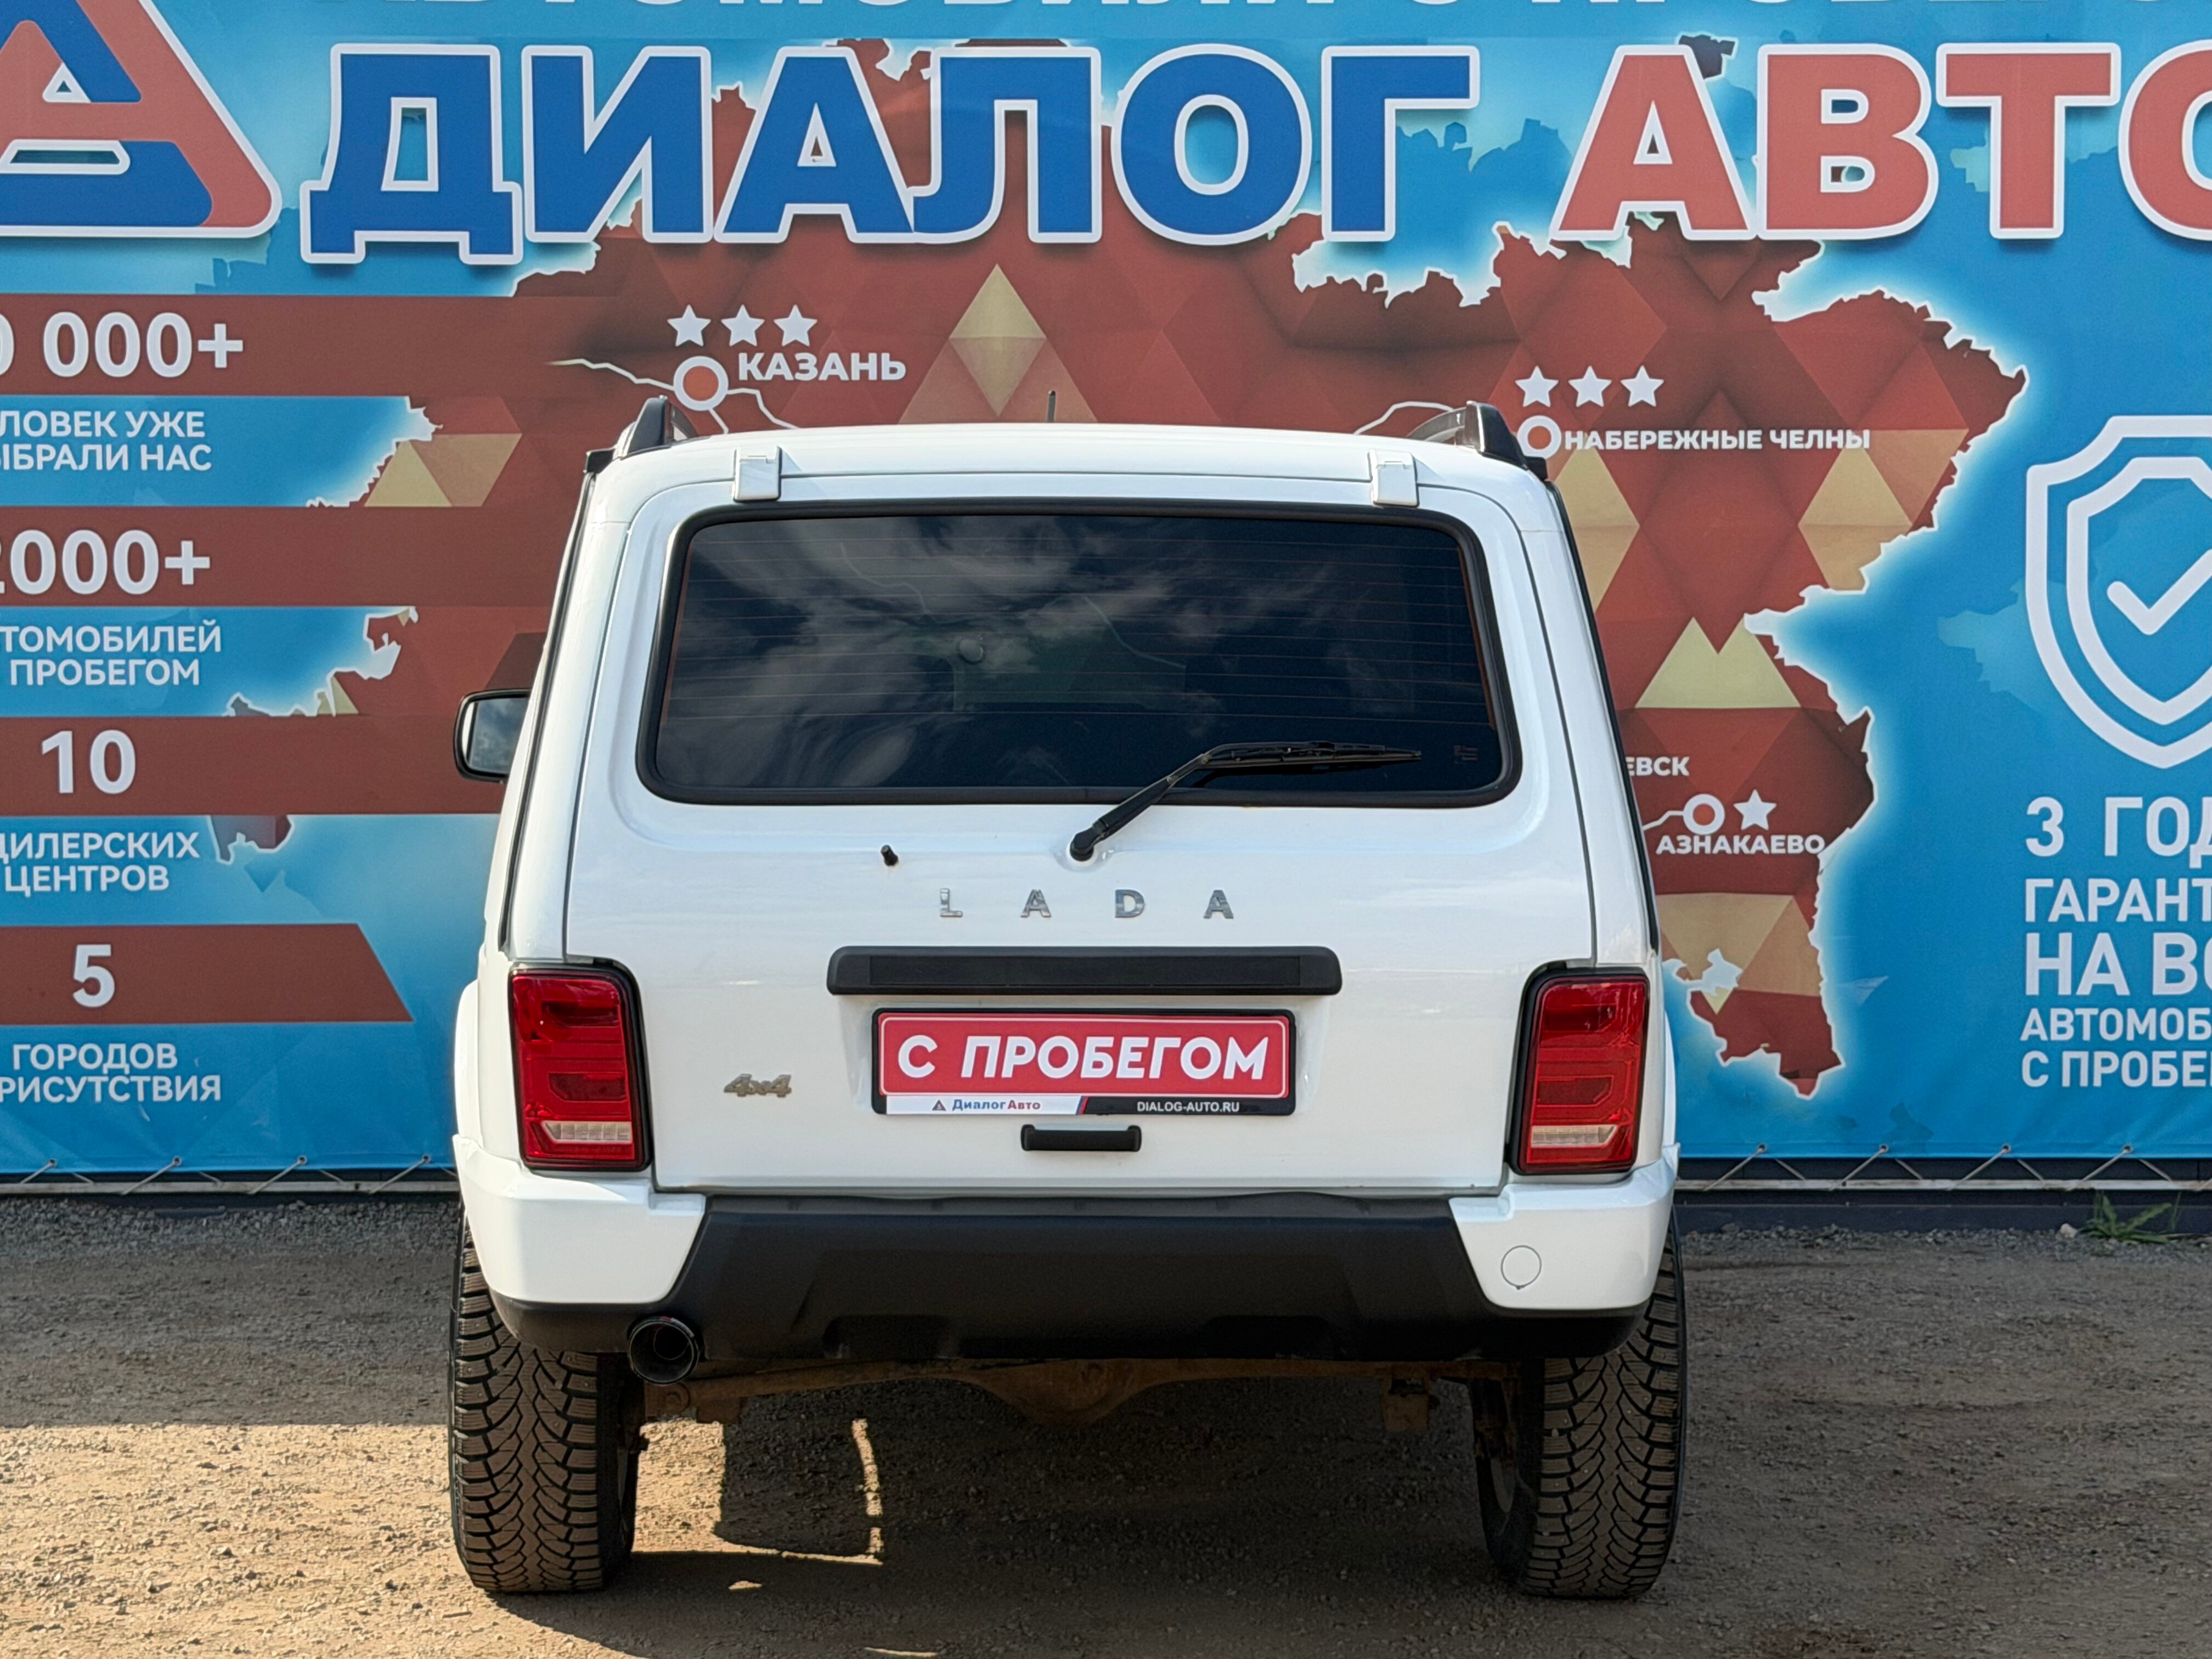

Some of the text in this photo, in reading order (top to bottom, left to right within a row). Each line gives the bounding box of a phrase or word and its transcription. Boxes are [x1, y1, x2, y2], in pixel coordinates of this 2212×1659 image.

[300, 44, 1480, 264] ДИАЛОГ
[738, 352, 906, 381] КАЗАНЬ
[125, 410, 205, 438] УЖЕ
[1565, 429, 1871, 450] НАБЕРЕЖНЫЕ ЧЕЛНЫ
[140, 444, 212, 471] НАС
[0, 529, 210, 595] 000+
[10, 659, 200, 686] ПРОБЕГОМ
[41, 730, 136, 794] 10
[1656, 835, 1825, 854] АЗНАКАЕВО
[5, 865, 170, 897] ЦЕНТРОВ
[940, 888, 1234, 919] LADA
[73, 944, 115, 1008] 5
[2025, 932, 2212, 996] НА В
[13, 1043, 178, 1073] ГОРОДОВ
[898, 1035, 1269, 1080] С ПРОБЕГОМ
[2022, 1050, 2212, 1087] С ПРОБЕ
[1137, 1102, 1240, 1112] DIALOG-AUTO.RU
